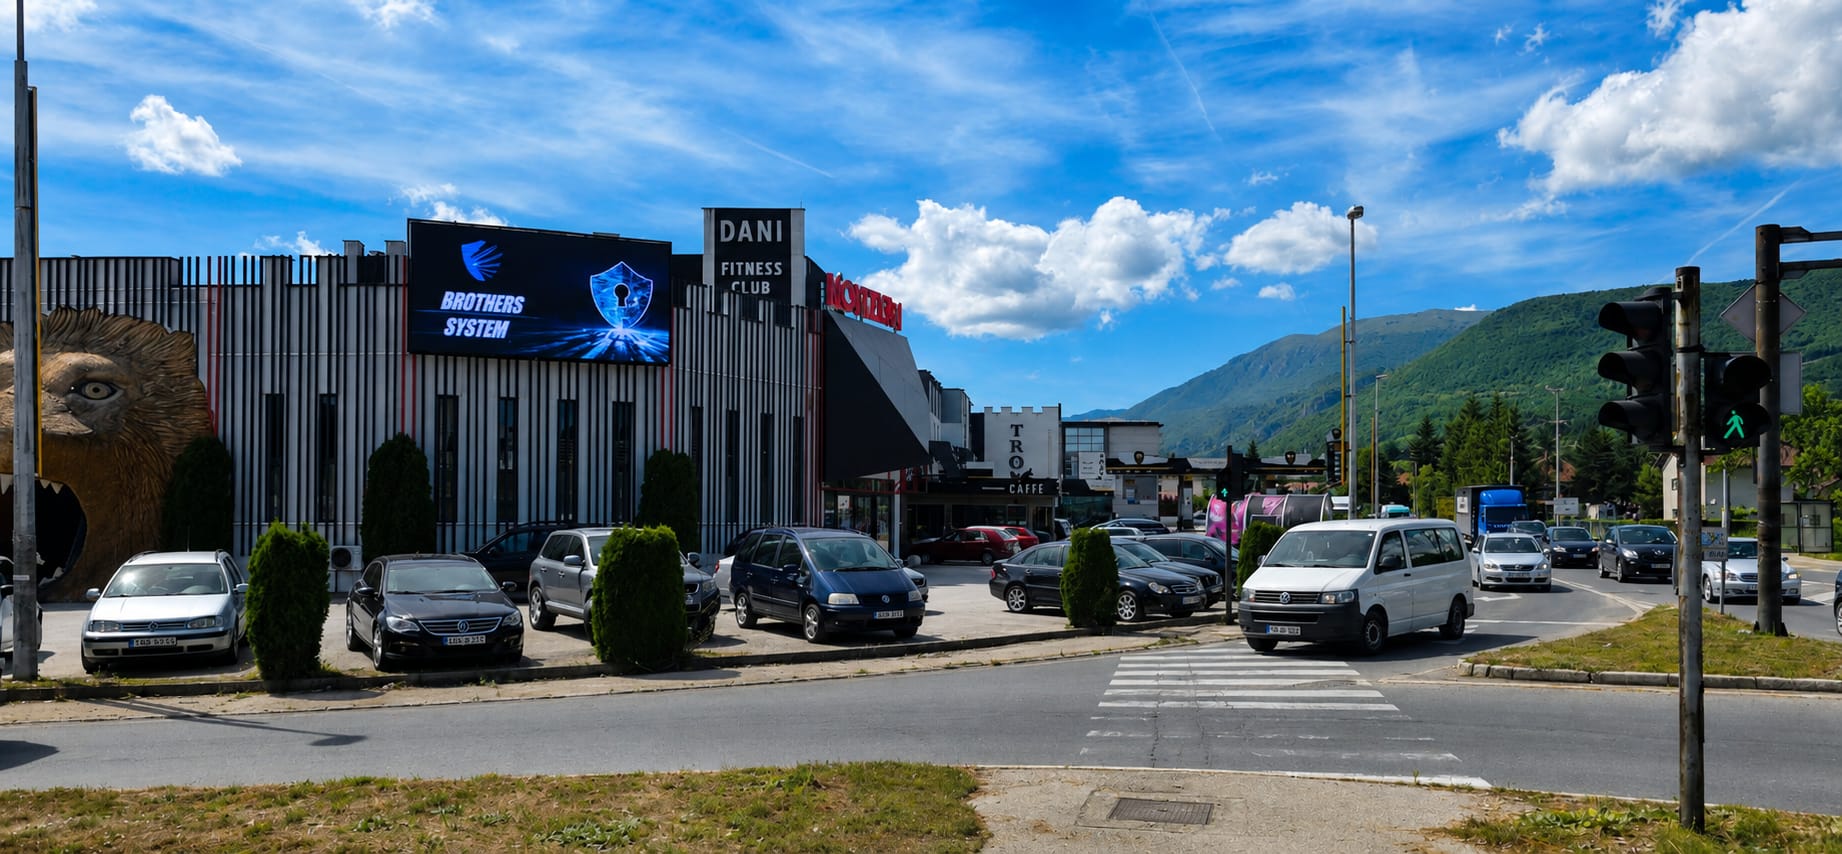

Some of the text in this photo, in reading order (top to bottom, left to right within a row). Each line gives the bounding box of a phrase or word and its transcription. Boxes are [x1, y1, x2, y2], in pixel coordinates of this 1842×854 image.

[720, 220, 783, 242] DANI
[721, 262, 783, 276] FITNESS
[731, 281, 771, 295] CLUB
[440, 291, 525, 314] BROTHERS
[443, 317, 510, 339] SYSTEM
[1009, 483, 1044, 495] CAFFE
